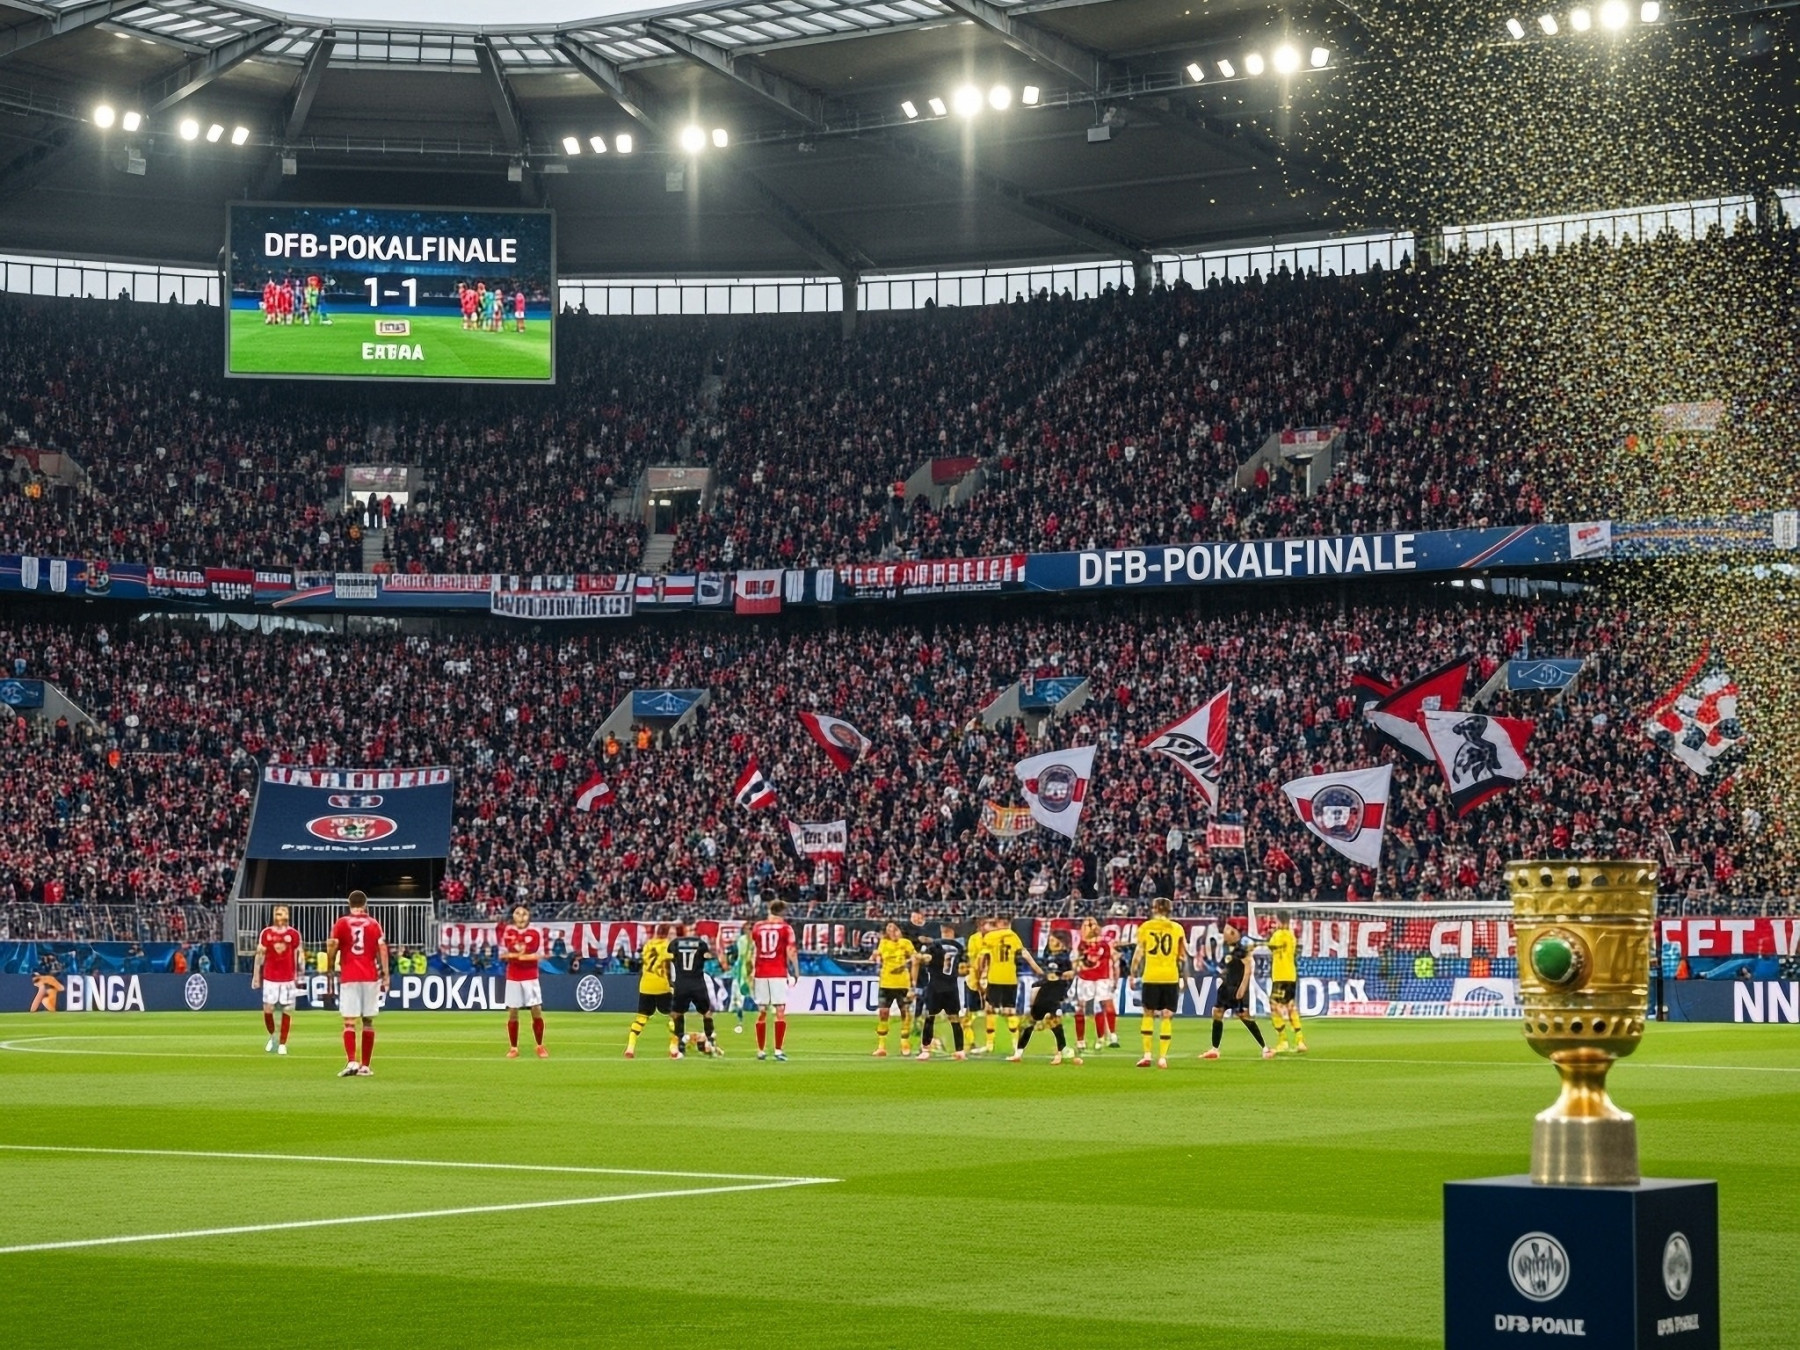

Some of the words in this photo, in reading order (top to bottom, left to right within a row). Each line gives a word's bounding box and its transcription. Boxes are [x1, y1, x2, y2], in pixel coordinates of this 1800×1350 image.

[264, 232, 517, 263] DFB-POKALFINALE
[364, 277, 417, 307] 1-1
[1079, 534, 1417, 587] DFB-POKALFINALE
